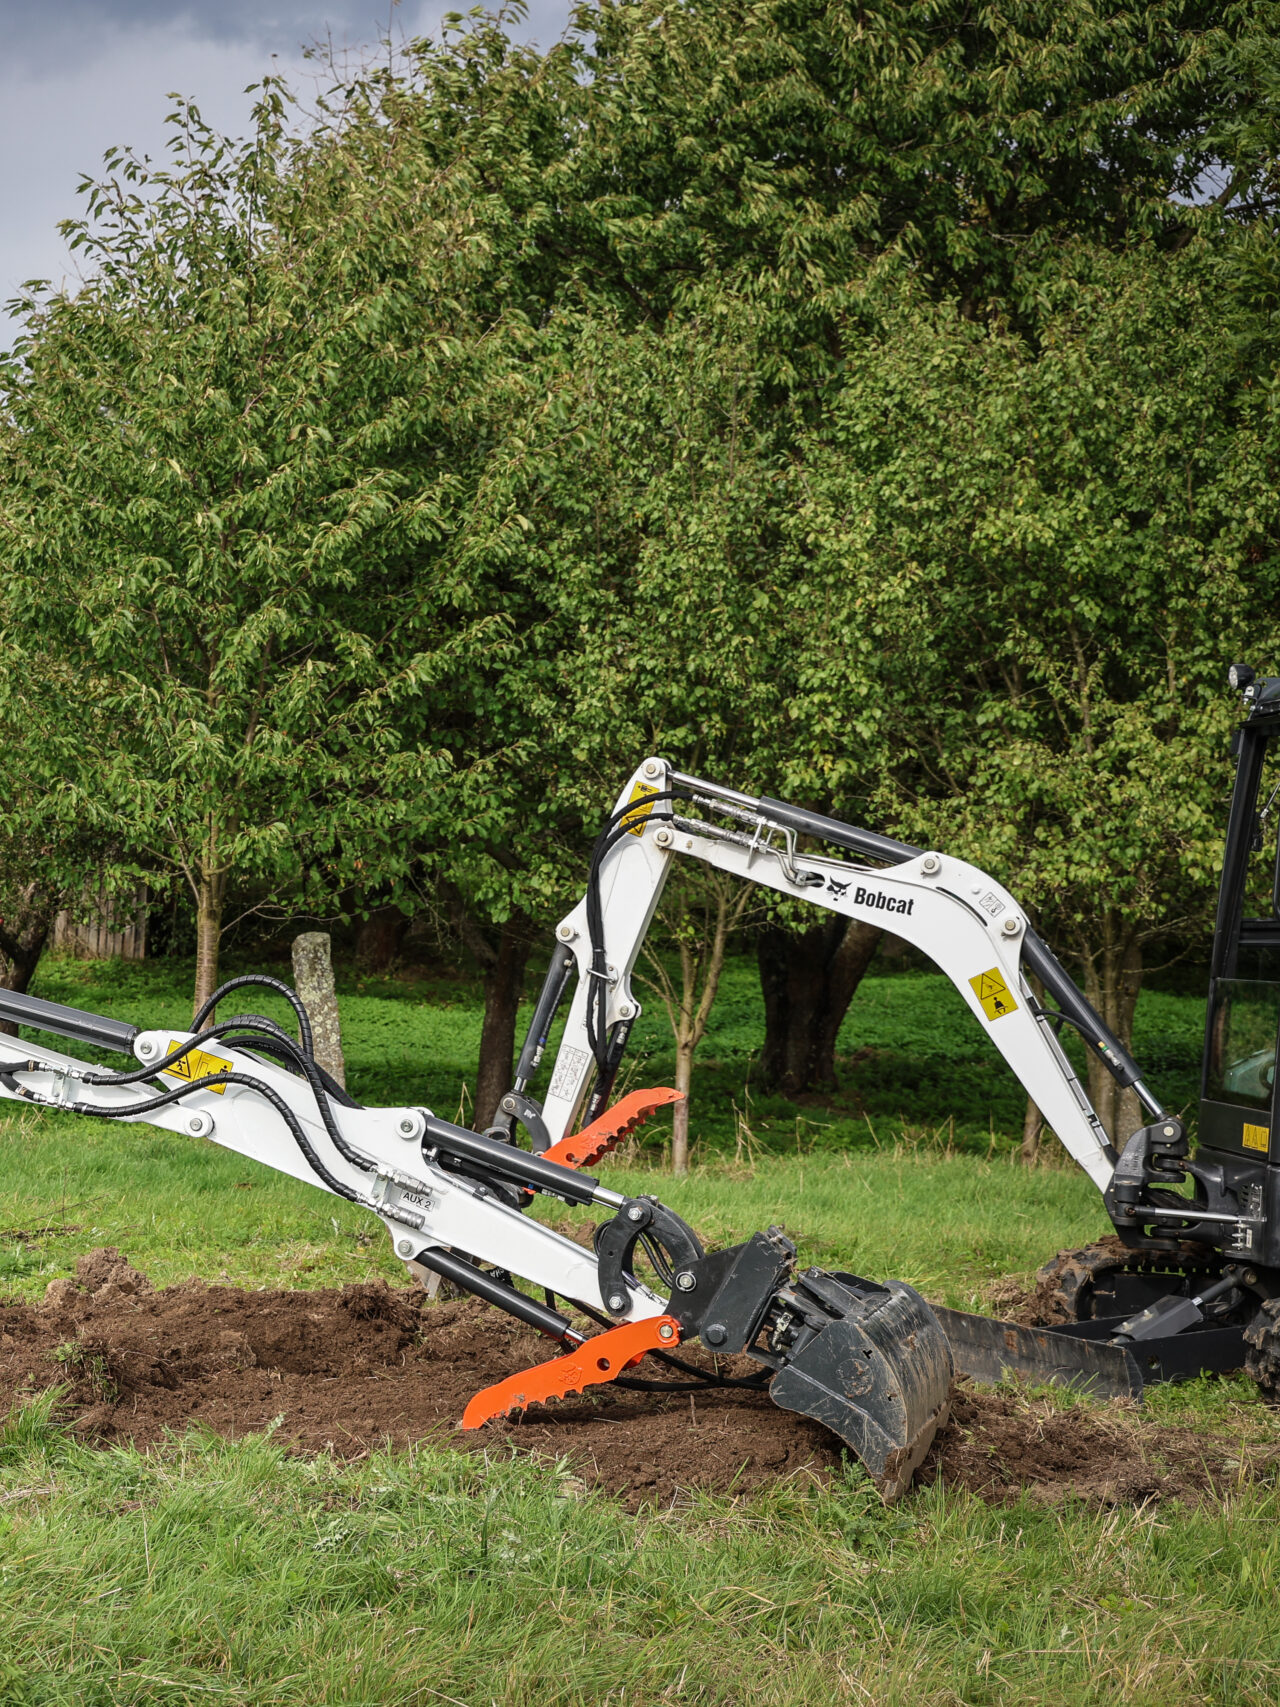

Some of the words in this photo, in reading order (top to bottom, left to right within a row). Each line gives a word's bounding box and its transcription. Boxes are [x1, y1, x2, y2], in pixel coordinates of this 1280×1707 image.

[853, 887, 914, 916] Bobcat
[403, 1192, 423, 1206] AUX
[424, 1200, 432, 1209] 2
